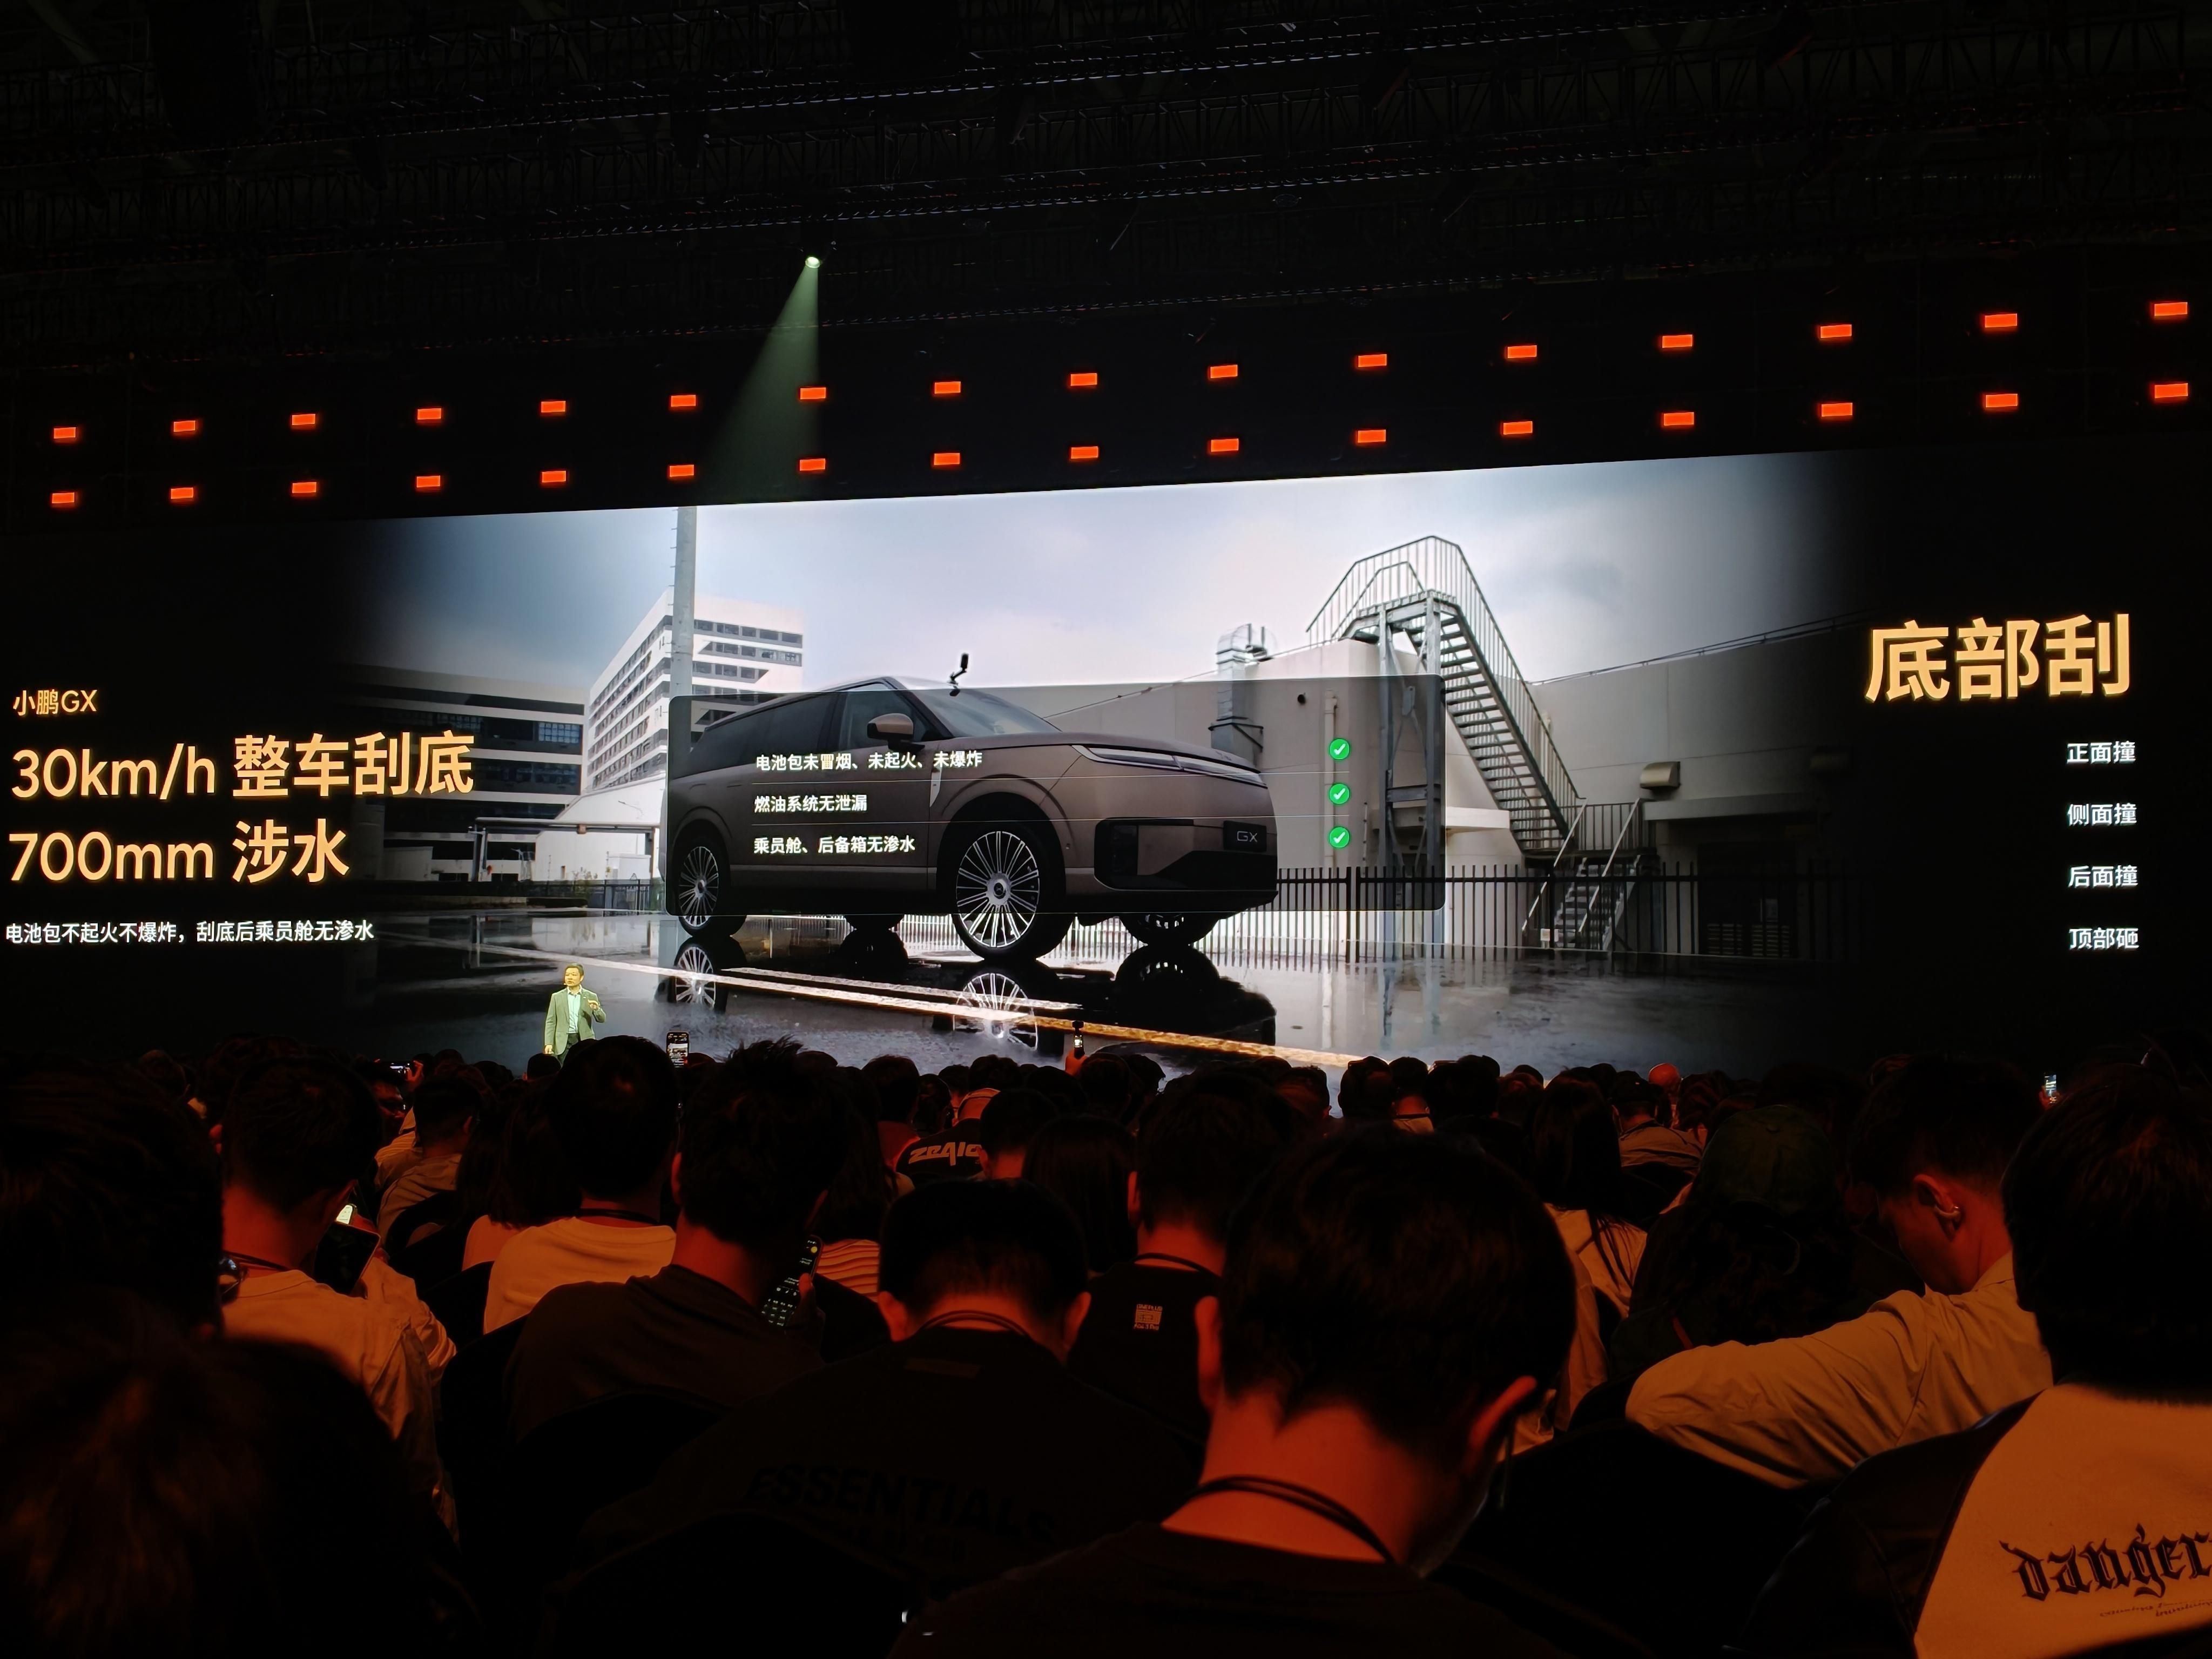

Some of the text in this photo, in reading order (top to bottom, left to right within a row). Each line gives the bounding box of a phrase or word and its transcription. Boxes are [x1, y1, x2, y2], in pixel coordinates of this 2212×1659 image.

[1865, 613, 2130, 703] 底部刮
[13, 689, 98, 716] 小鹏GX
[756, 750, 983, 771] 电池包未冒烟、未起火、未爆炸
[2067, 740, 2136, 764] 正面撞
[12, 729, 475, 800] 30km/h 整车刮底
[754, 794, 867, 813] 燃油系统无泄漏
[2067, 802, 2137, 826] 侧面撞
[754, 835, 916, 854] 乘员舱、后备箱无渗水
[1237, 831, 1258, 842] GX
[9, 818, 350, 883] 700mm 涉水
[2068, 865, 2139, 888] 后面撞
[6, 919, 375, 945] 电池包不起火不爆炸，刮底后乘员舱无渗水
[2068, 927, 2140, 950] 顶部砸
[1998, 1522, 2212, 1601] danger
